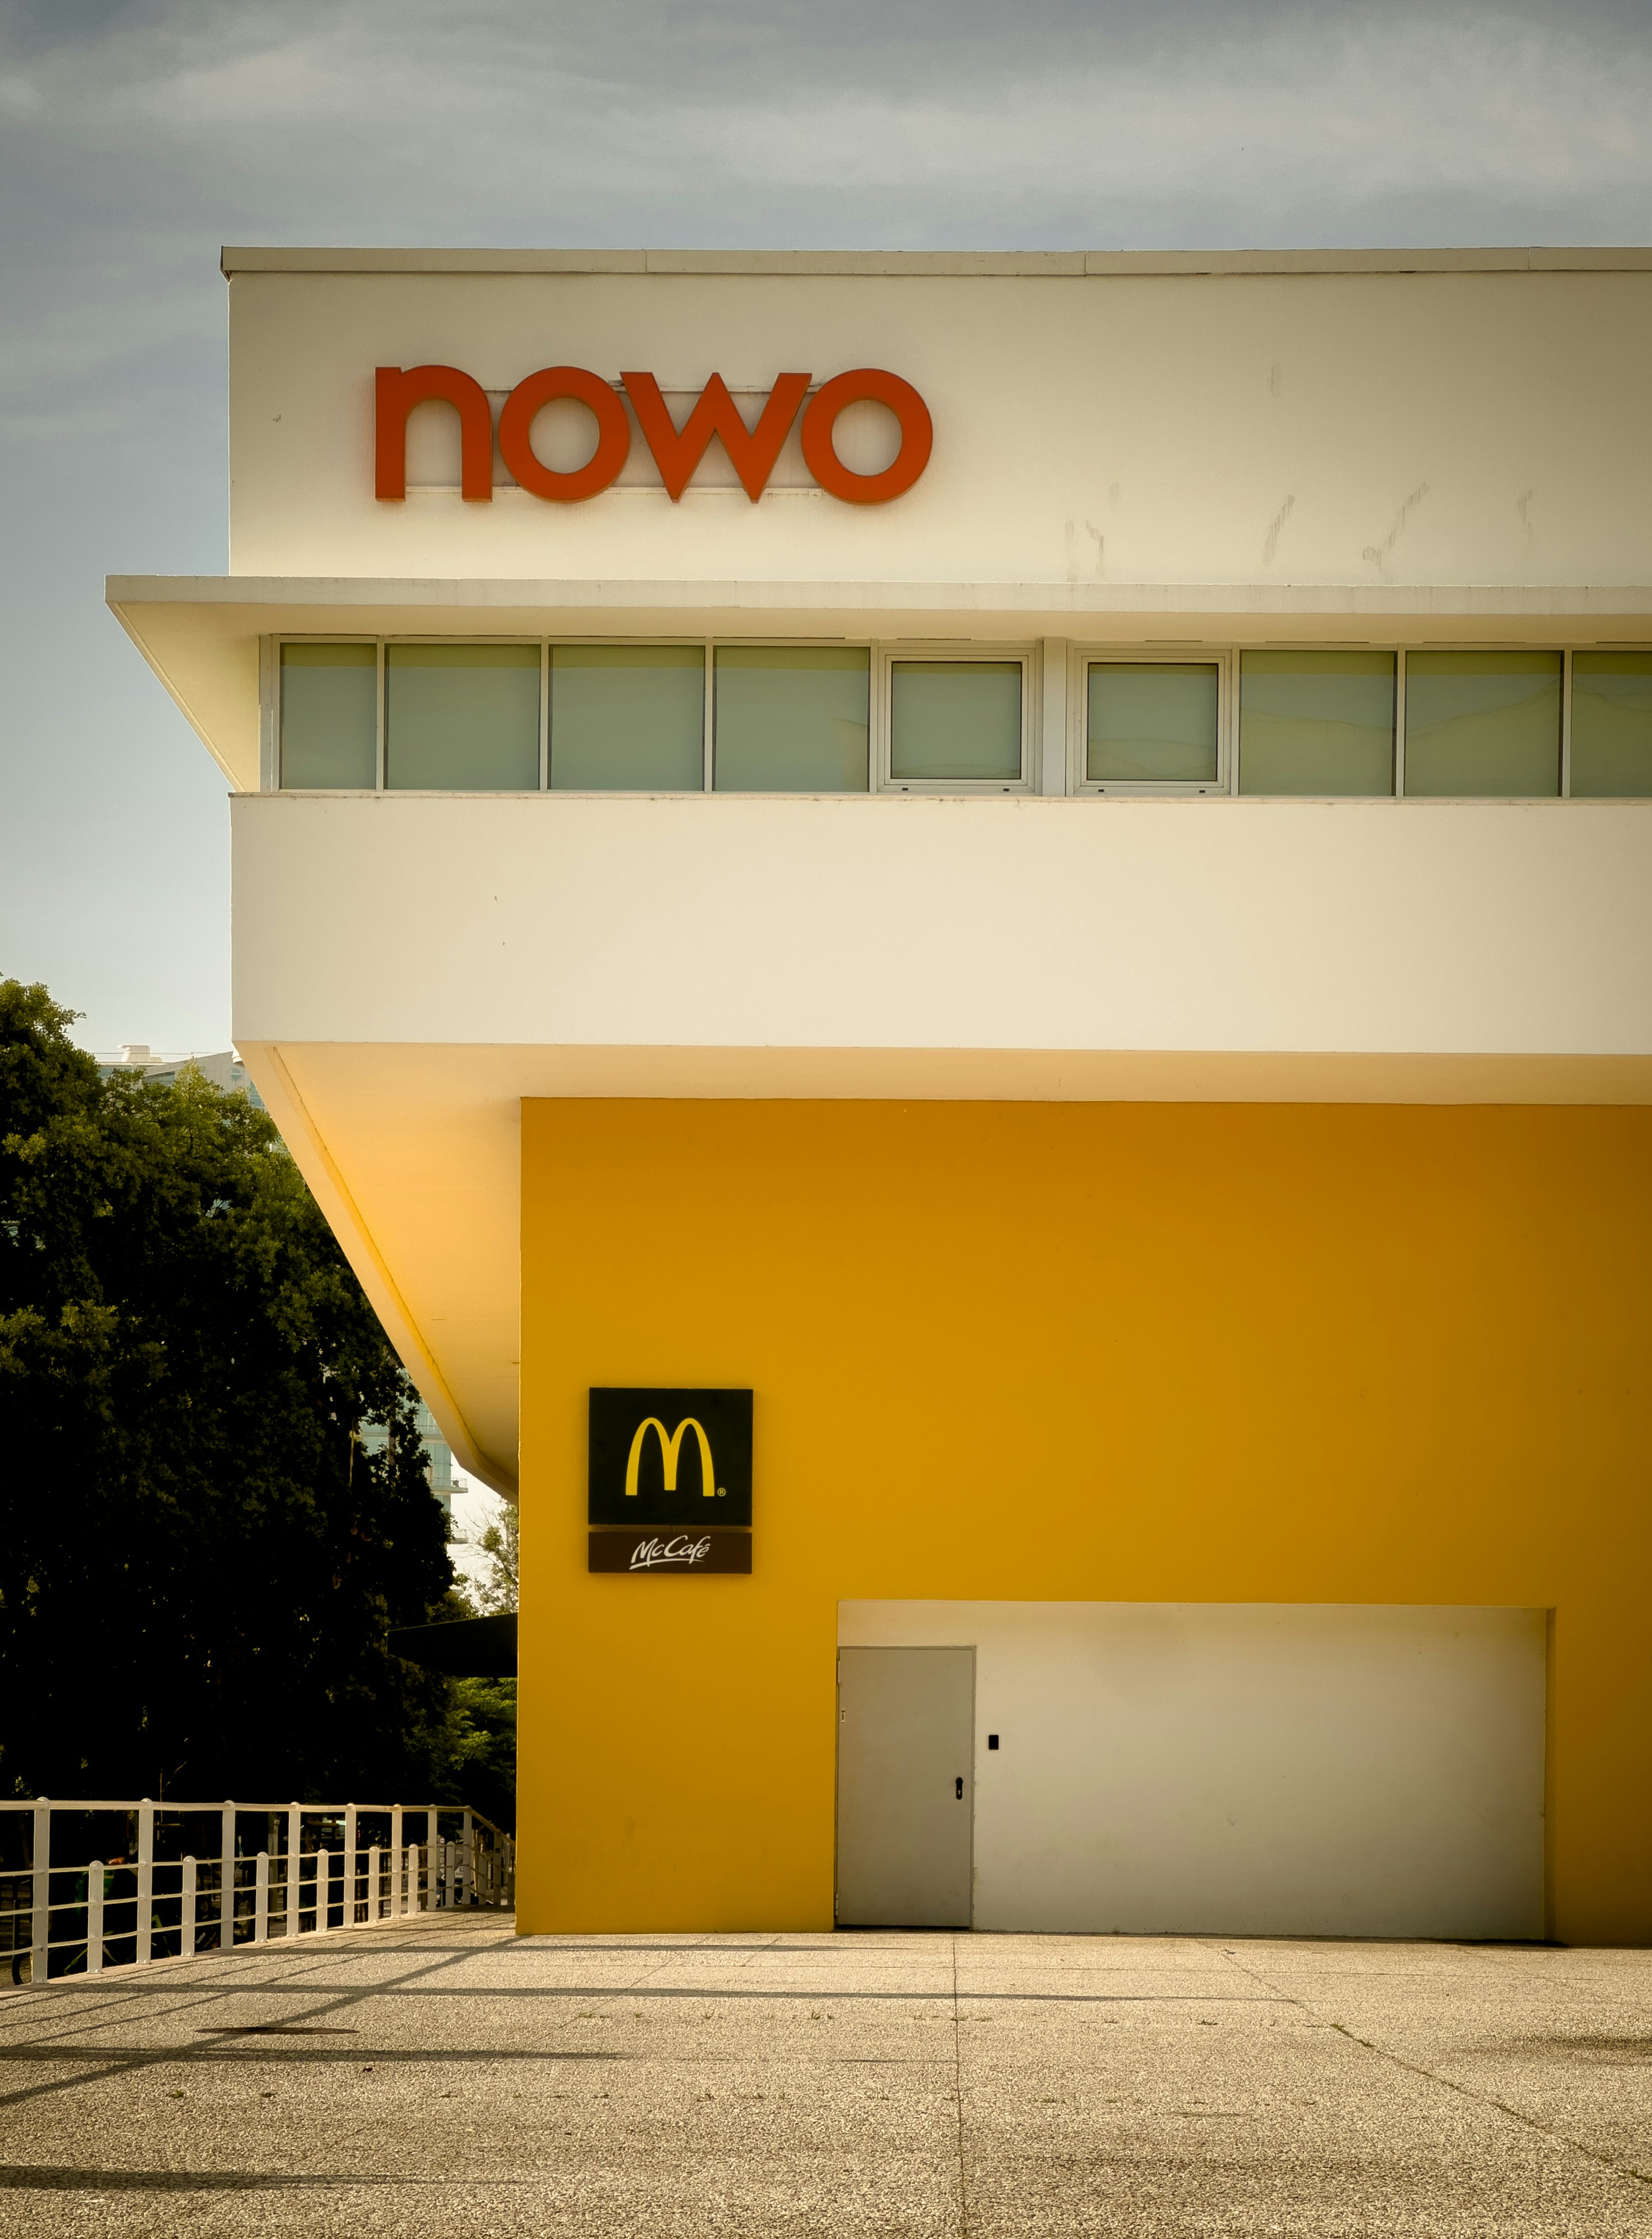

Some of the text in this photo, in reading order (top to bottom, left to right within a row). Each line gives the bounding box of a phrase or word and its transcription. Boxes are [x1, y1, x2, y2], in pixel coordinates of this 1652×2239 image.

[375, 365, 933, 505] nowo
[626, 1417, 715, 1497] M
[630, 1534, 711, 1568] McCafé
